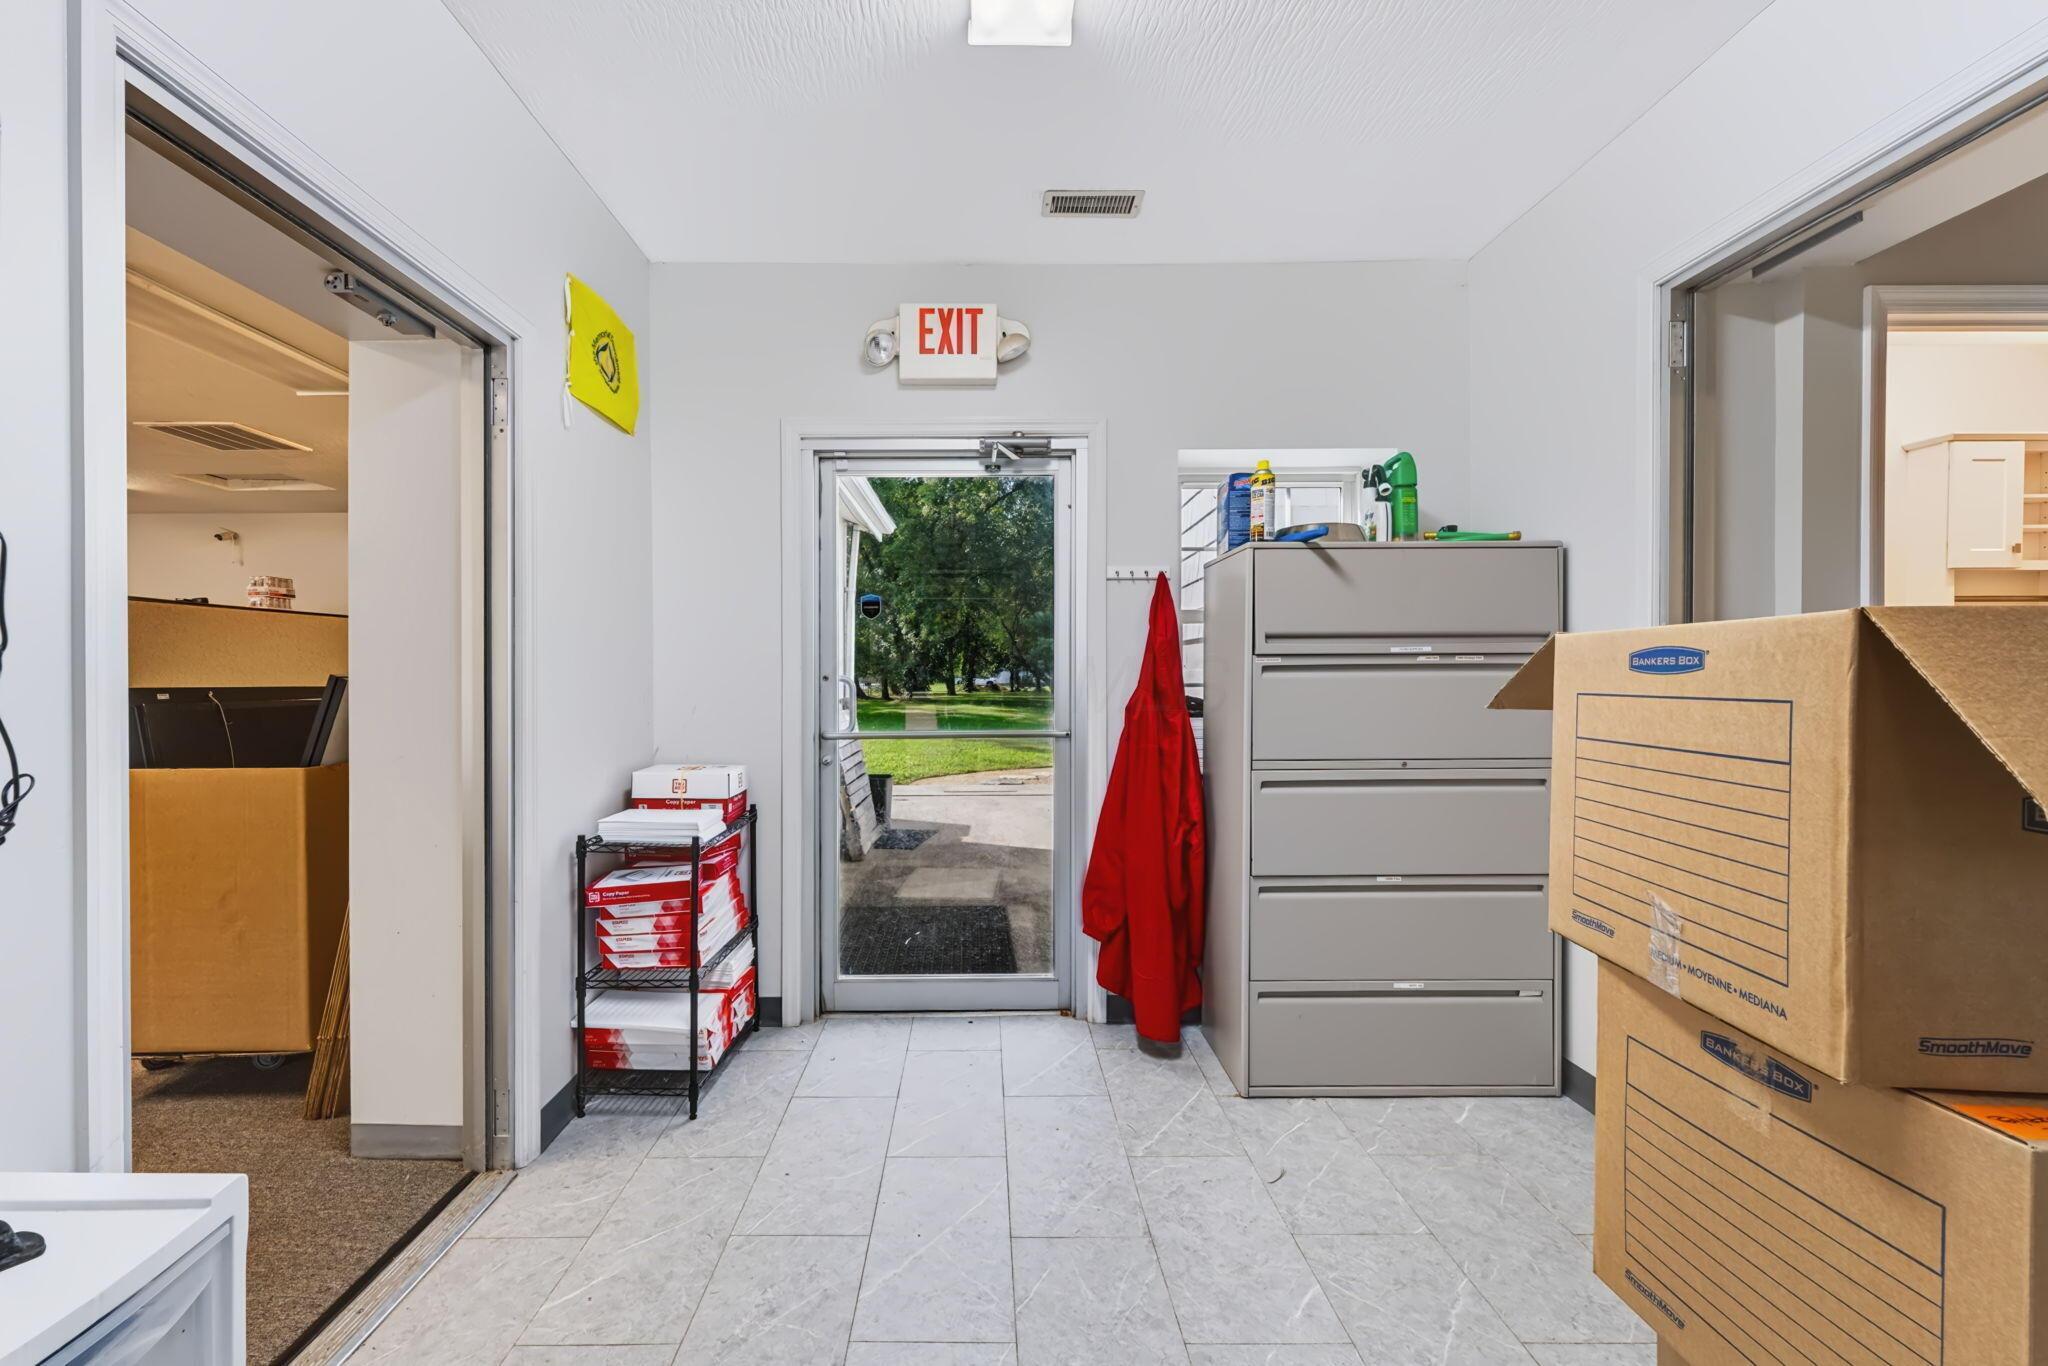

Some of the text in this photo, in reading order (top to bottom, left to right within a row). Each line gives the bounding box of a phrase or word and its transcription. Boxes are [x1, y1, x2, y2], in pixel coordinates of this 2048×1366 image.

[919, 308, 983, 354] EXIT
[1632, 655, 1700, 666] BANKERS BOX
[1572, 910, 1614, 936] SmoothMove
[1651, 949, 1788, 1020] MEDIUM MOYENNE MEDIANA
[1706, 1038, 1804, 1094] BANKES BOX
[1918, 1040, 2032, 1055] SmoothMove
[1624, 1268, 1686, 1329] SmoothMove
